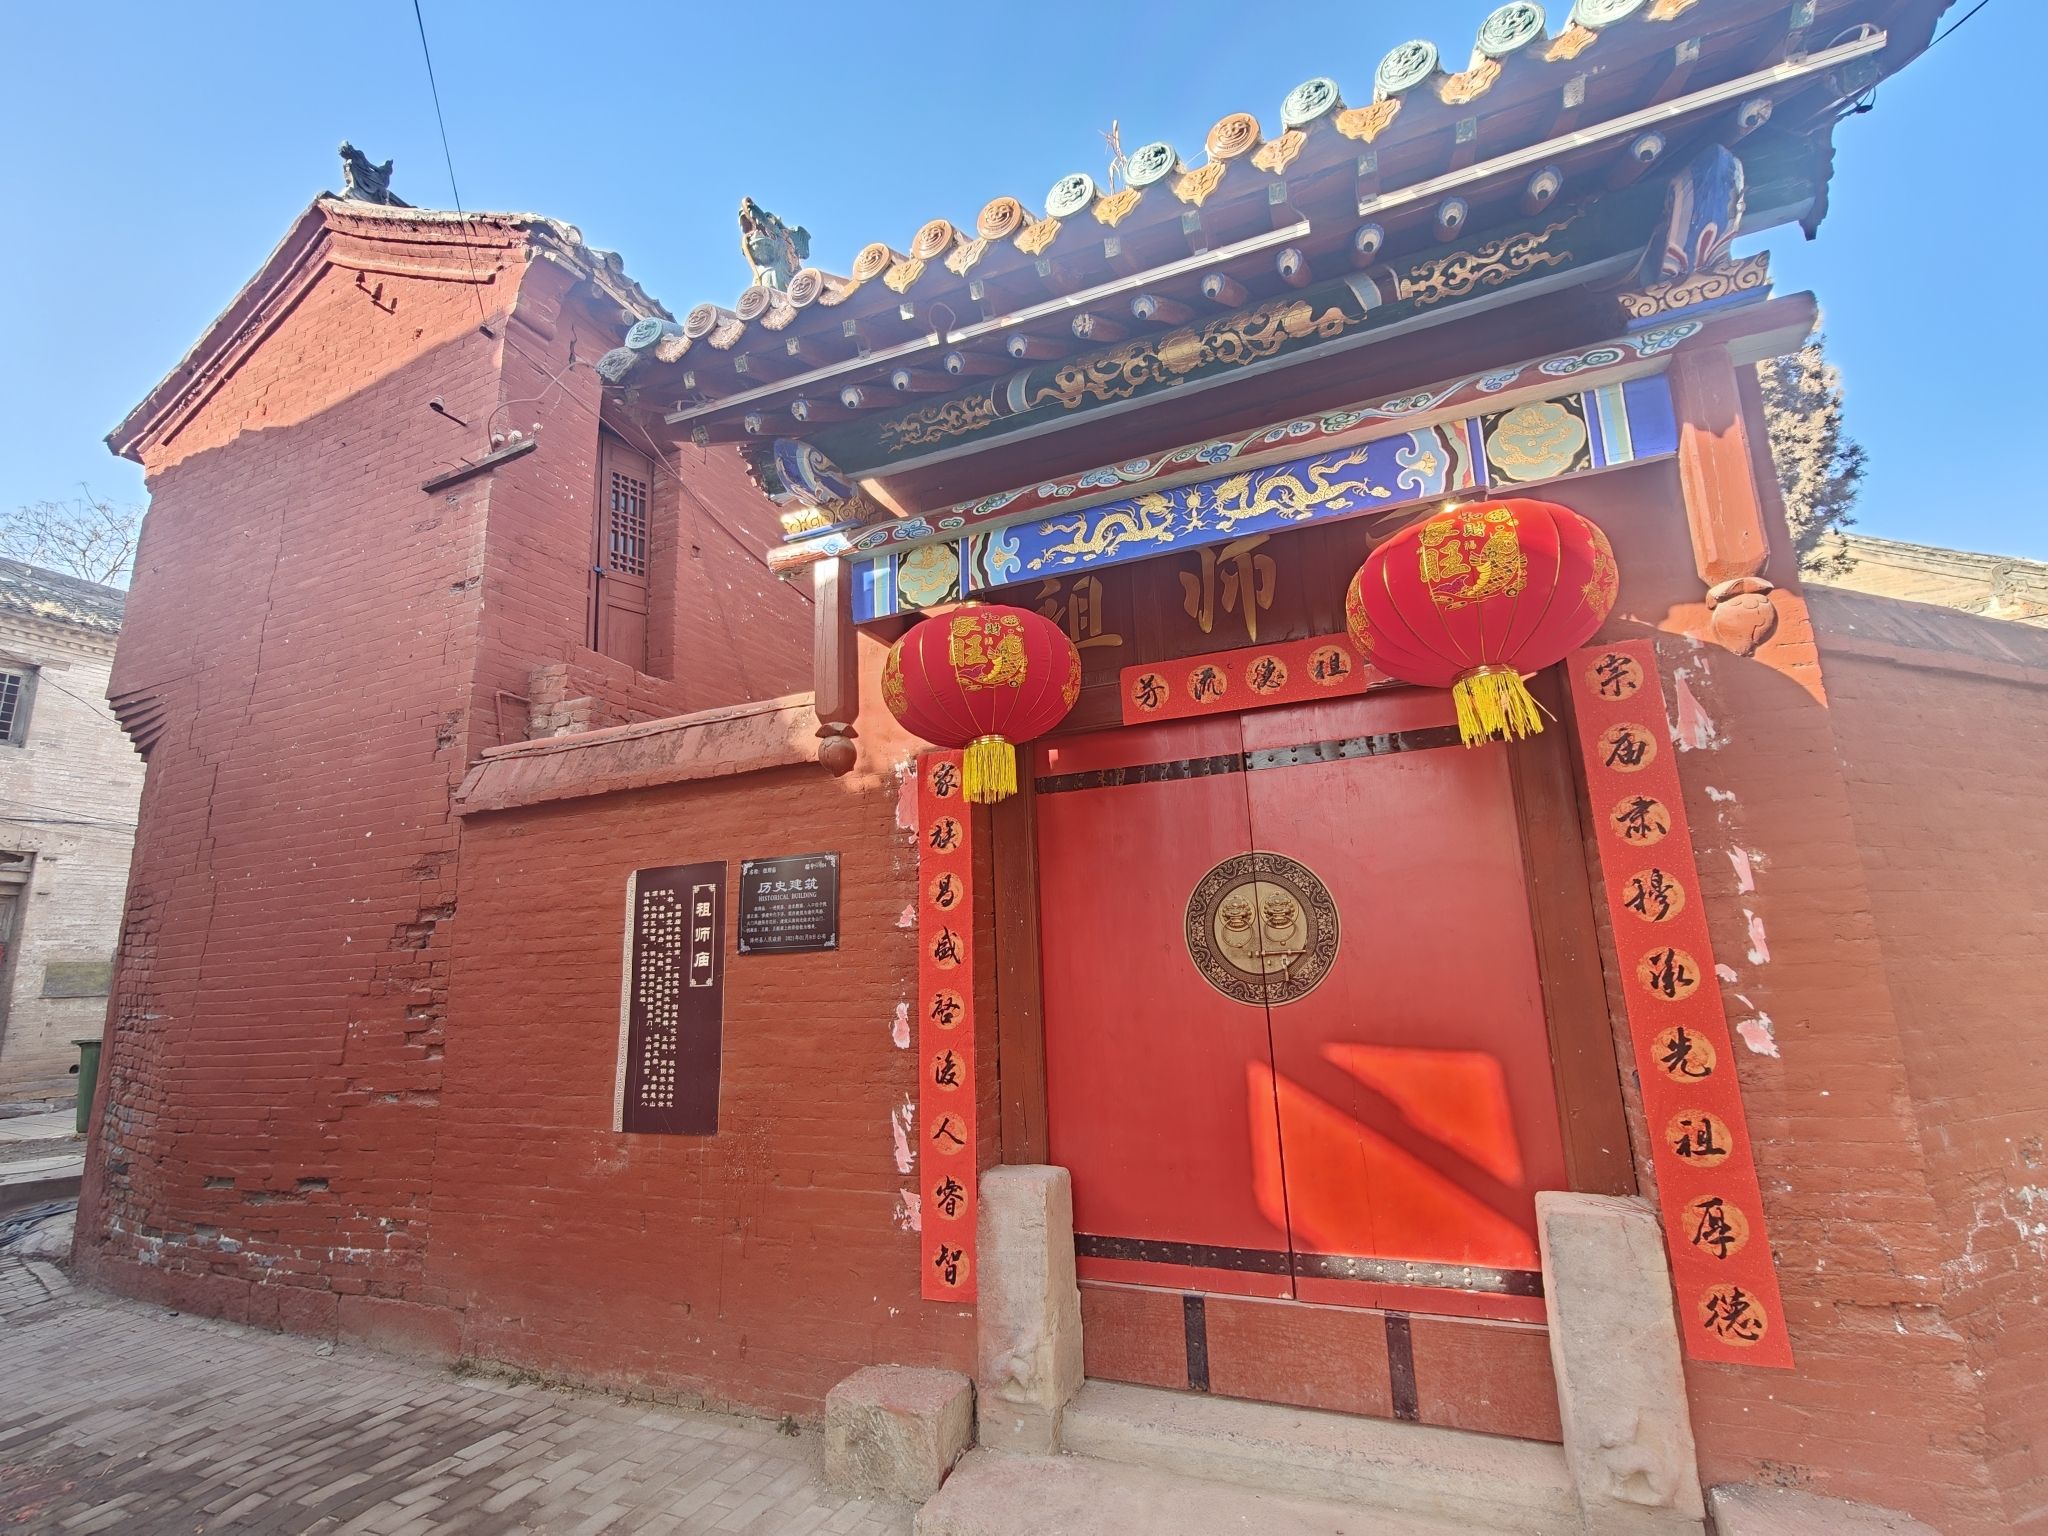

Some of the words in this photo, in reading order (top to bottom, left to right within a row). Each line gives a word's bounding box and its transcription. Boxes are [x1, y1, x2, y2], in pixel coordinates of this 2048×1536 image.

[757, 877, 819, 894] 历史建筑
[758, 893, 790, 903] HISTORICAL
[791, 891, 817, 900] BUILDING
[693, 901, 713, 968] 祖师庙
